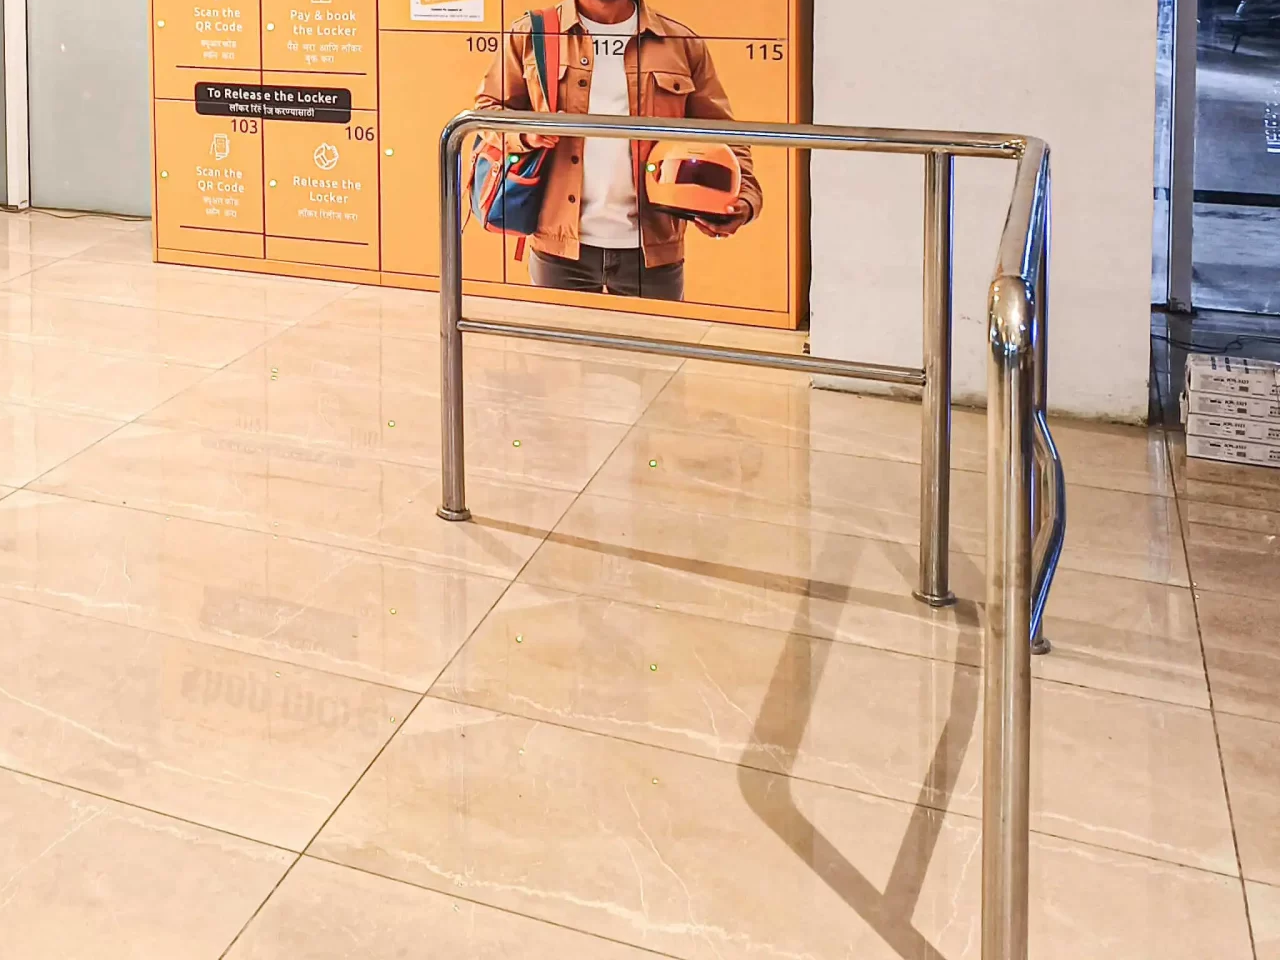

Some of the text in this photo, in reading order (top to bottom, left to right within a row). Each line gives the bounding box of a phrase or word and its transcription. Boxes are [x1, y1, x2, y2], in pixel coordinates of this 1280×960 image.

[194, 7, 241, 18] Scan the
[290, 10, 357, 22] Pay & book
[195, 21, 243, 32] QR Code
[293, 24, 357, 36] the Locker
[466, 36, 498, 53] 109
[592, 39, 624, 56] 112
[745, 43, 784, 61] 115
[207, 87, 338, 104] To Release the Locker
[231, 118, 258, 134] 103
[345, 126, 375, 141] 106
[196, 166, 243, 179] Scan the
[198, 180, 245, 193] QR Code
[293, 176, 362, 190] Release the
[309, 192, 349, 204] Locker
